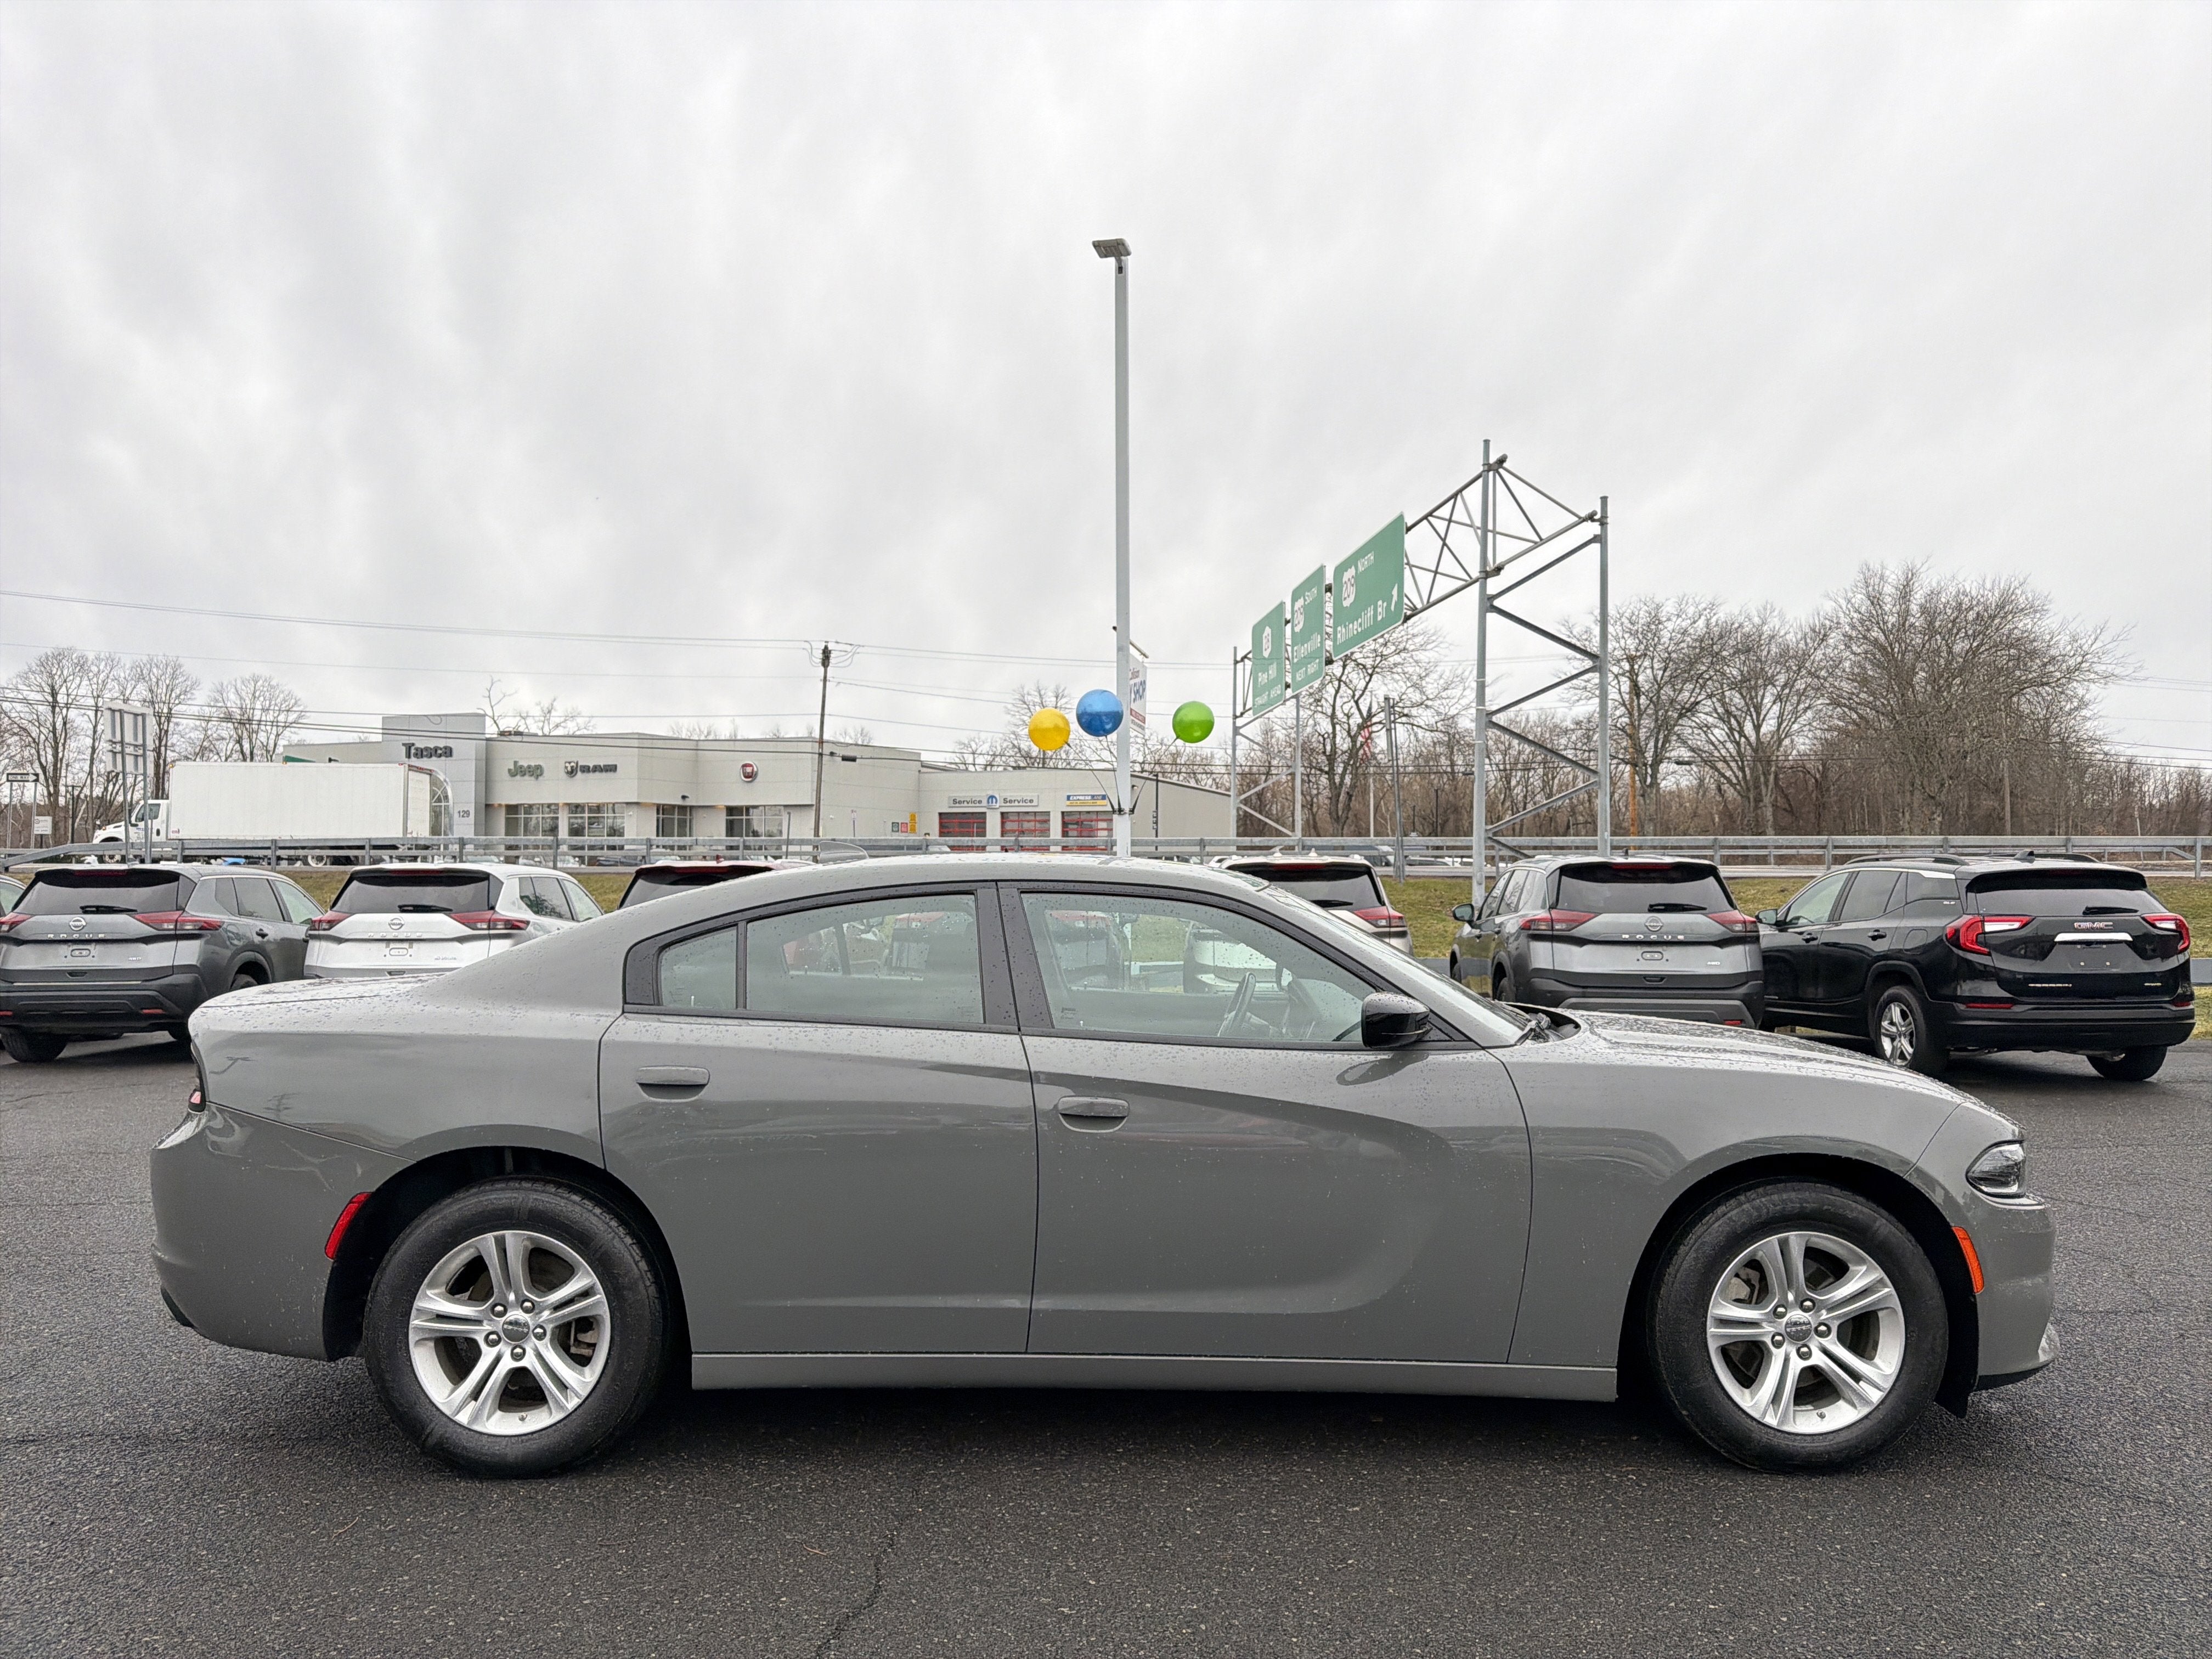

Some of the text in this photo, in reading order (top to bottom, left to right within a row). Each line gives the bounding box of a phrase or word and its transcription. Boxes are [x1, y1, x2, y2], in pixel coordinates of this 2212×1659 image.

[1357, 551, 1374, 574] NORTH
[1343, 574, 1355, 601] 209
[1336, 600, 1387, 645] Rhinecliff Br
[1294, 632, 1321, 663] Ellenville
[1133, 679, 1146, 704] SHOP
[402, 742, 453, 759] Tasca
[508, 760, 544, 780] Jeep
[579, 764, 618, 774] RAM
[458, 810, 471, 818] 129
[2074, 922, 2113, 930] GMC
